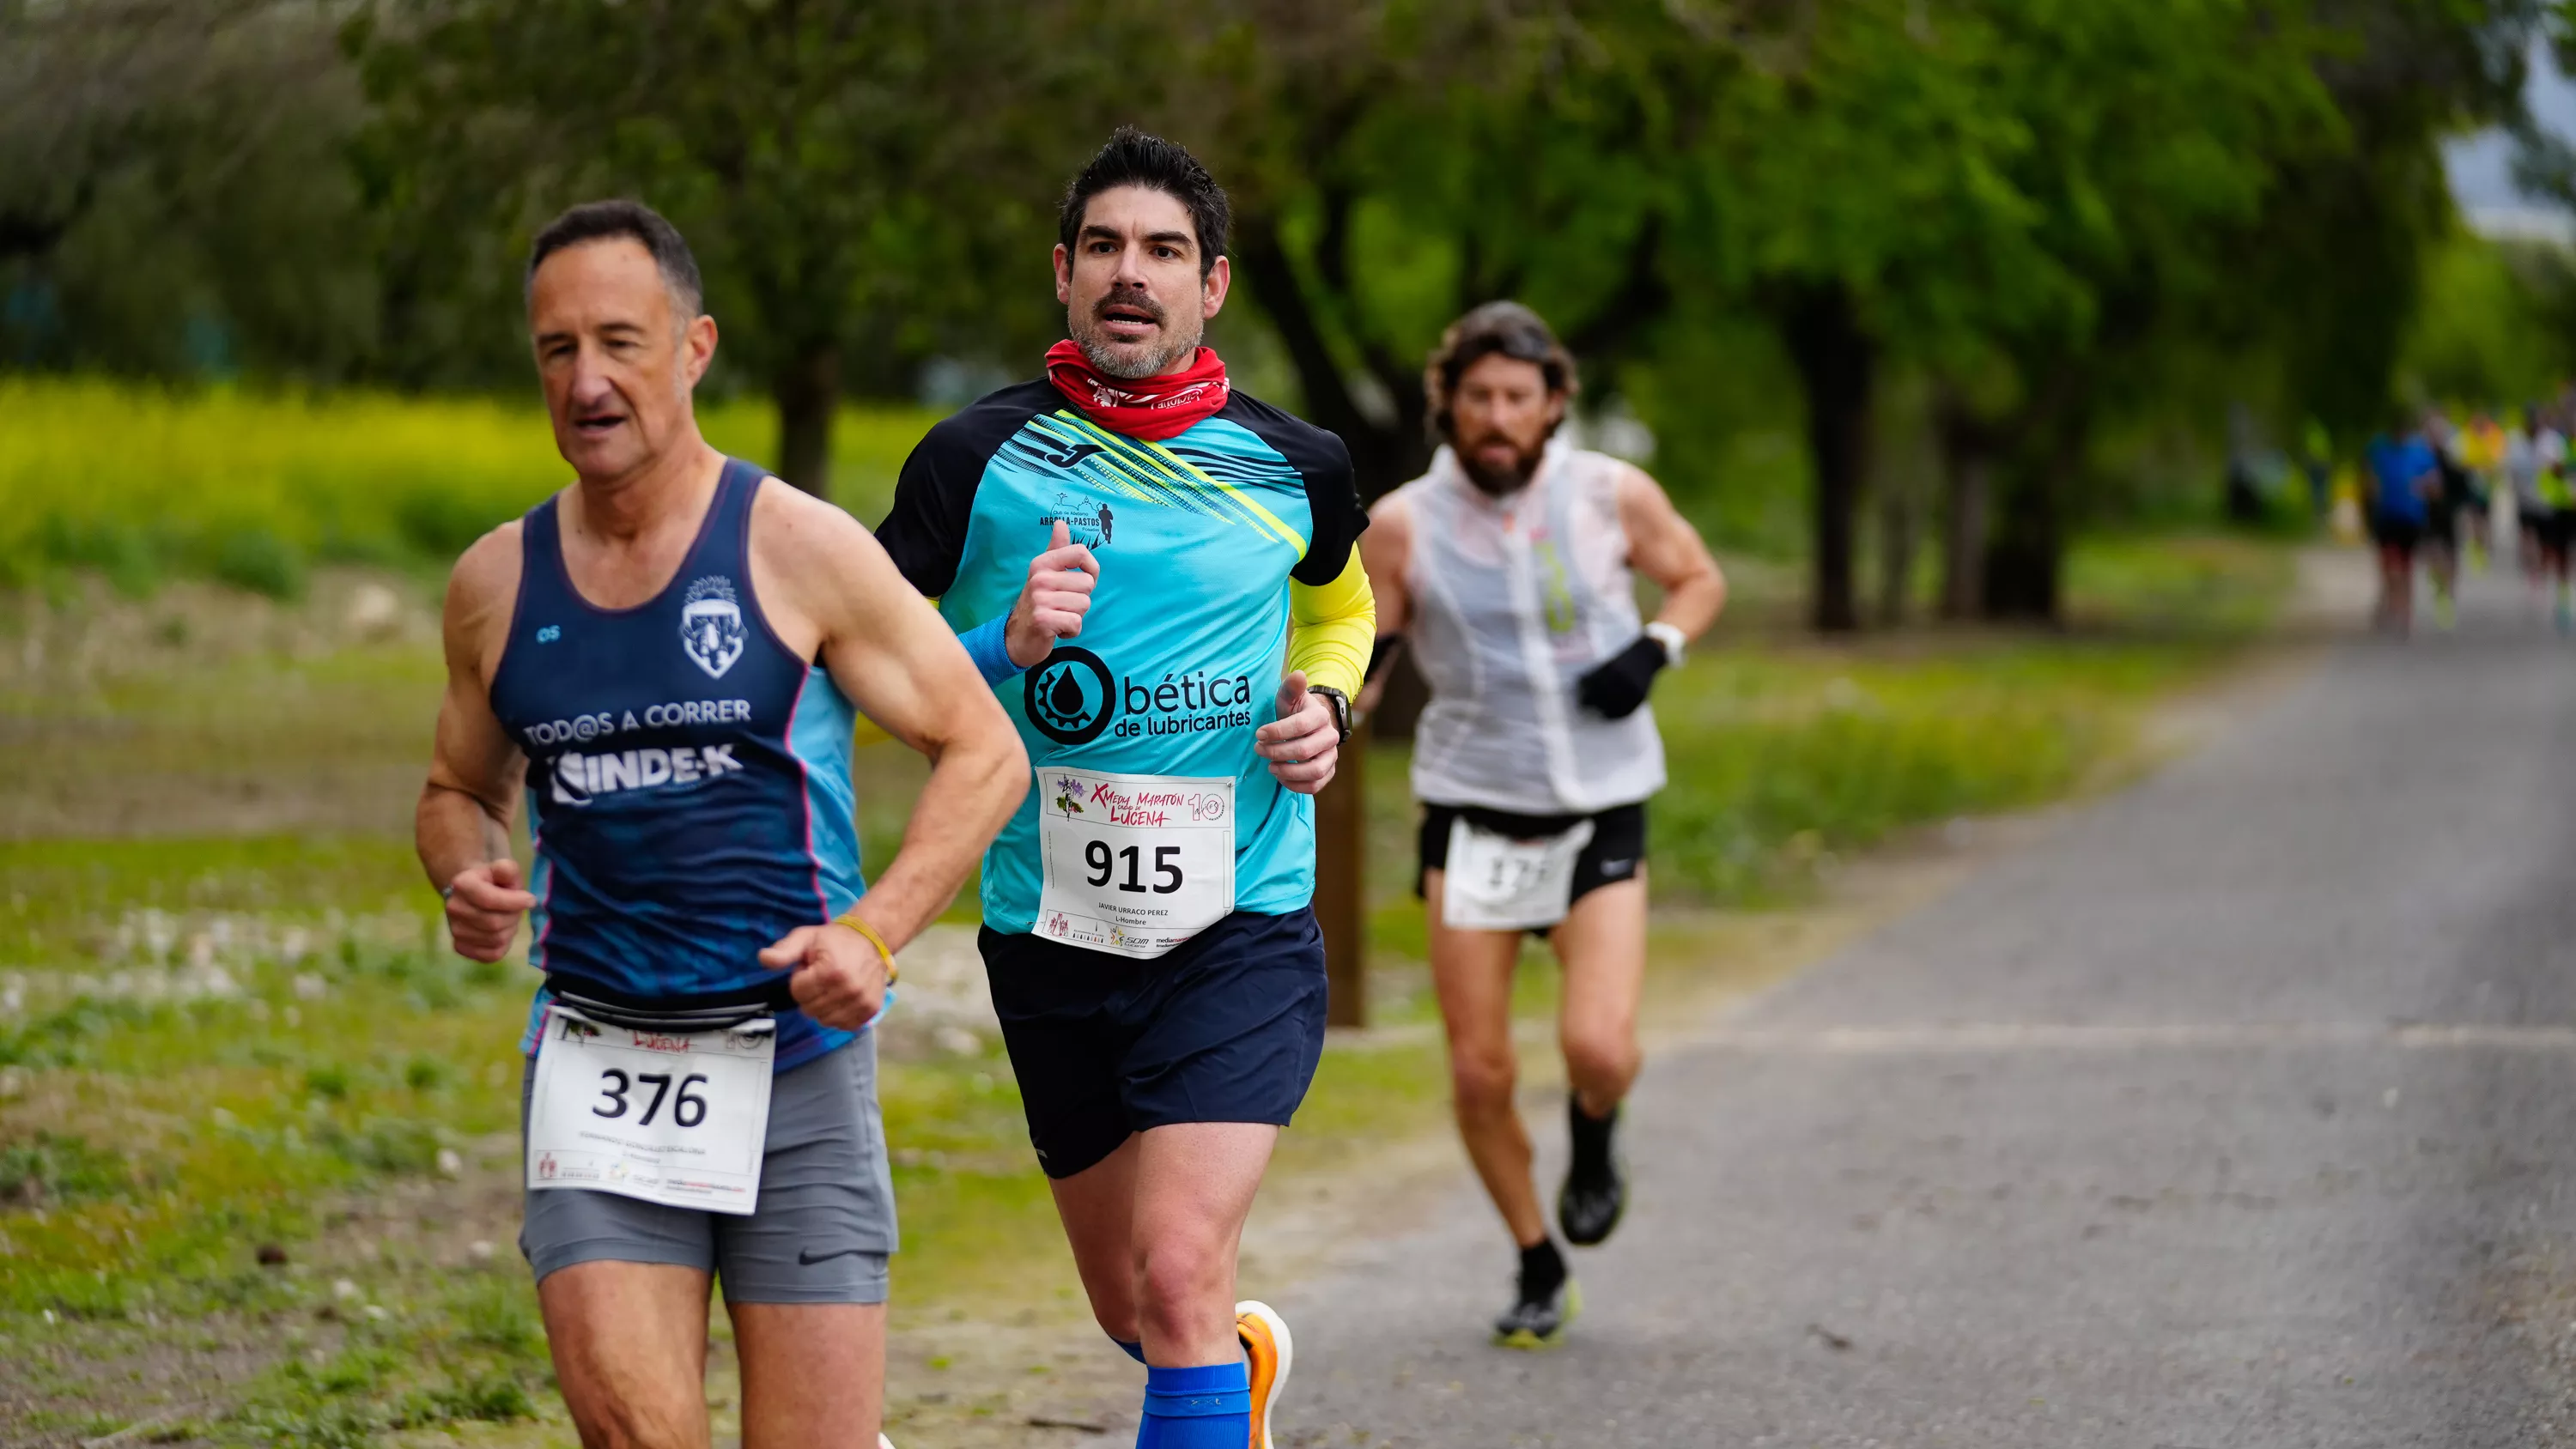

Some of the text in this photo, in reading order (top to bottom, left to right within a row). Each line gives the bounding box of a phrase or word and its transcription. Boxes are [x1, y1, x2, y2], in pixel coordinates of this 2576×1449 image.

[1124, 671, 1250, 715] bética
[523, 699, 751, 746] TOD@S A CORRER
[1115, 710, 1251, 737] de lubricantes
[1137, 792, 1184, 806] MARATÓN
[1110, 805, 1172, 827] LUCENA
[1085, 840, 1183, 894] 915
[1115, 916, 1146, 925] L-Hombre
[1118, 906, 1146, 916] URRACO
[592, 1067, 708, 1128] 376
